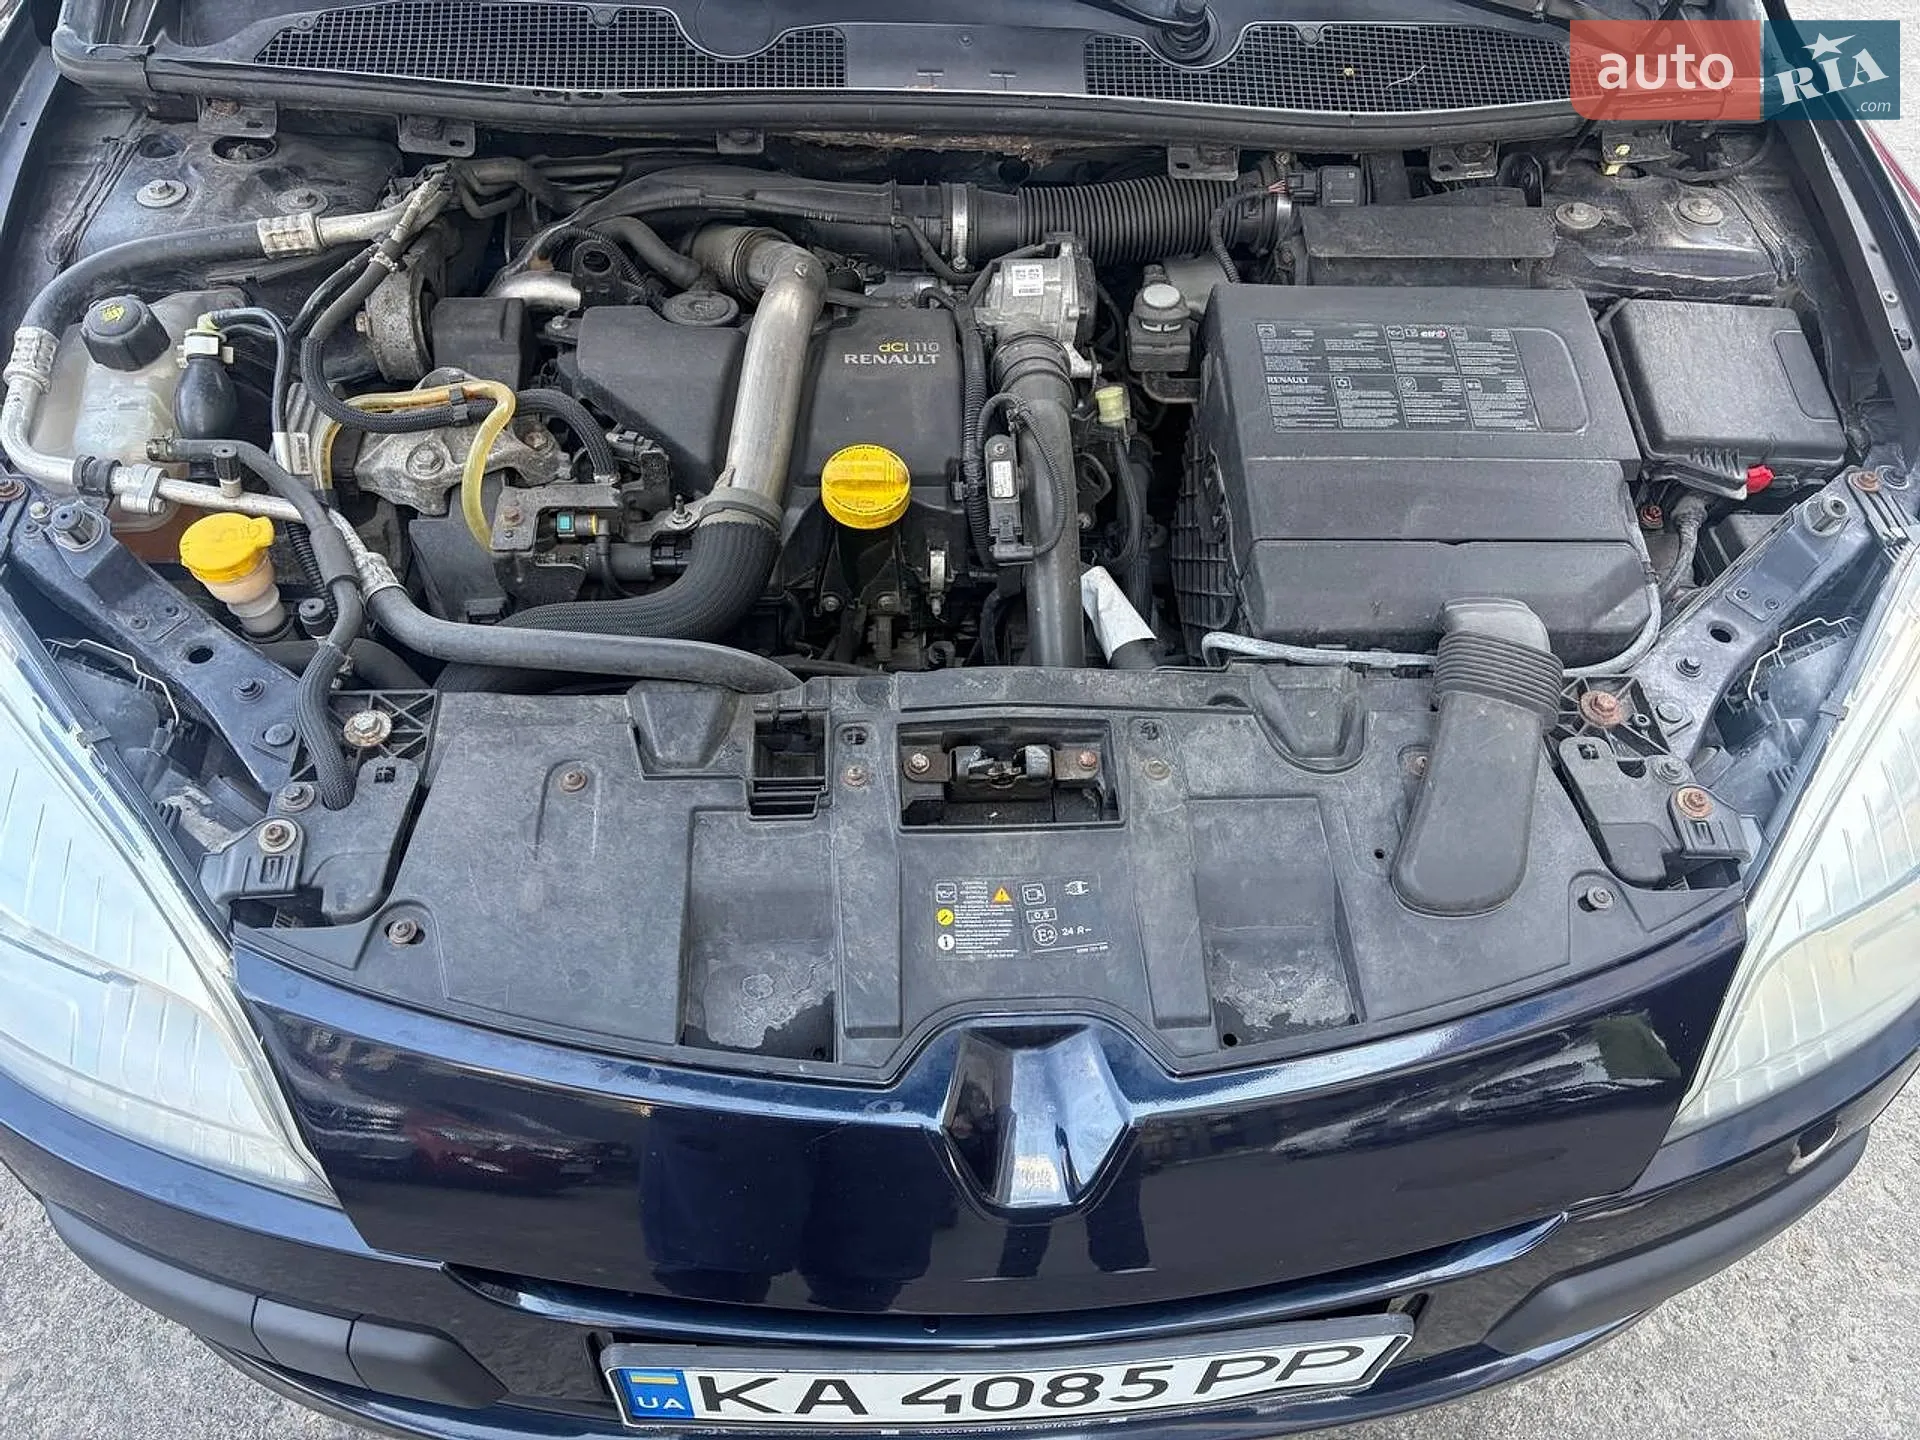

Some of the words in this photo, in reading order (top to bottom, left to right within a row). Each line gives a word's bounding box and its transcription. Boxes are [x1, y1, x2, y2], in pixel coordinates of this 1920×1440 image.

[914, 342, 939, 352] 110
[844, 354, 940, 364] RENAULT
[1266, 376, 1309, 384] RENAULT
[697, 1375, 865, 1415] KA
[901, 1365, 1174, 1414] 4085
[1194, 1345, 1365, 1395] PP
[637, 1396, 685, 1410] UA
